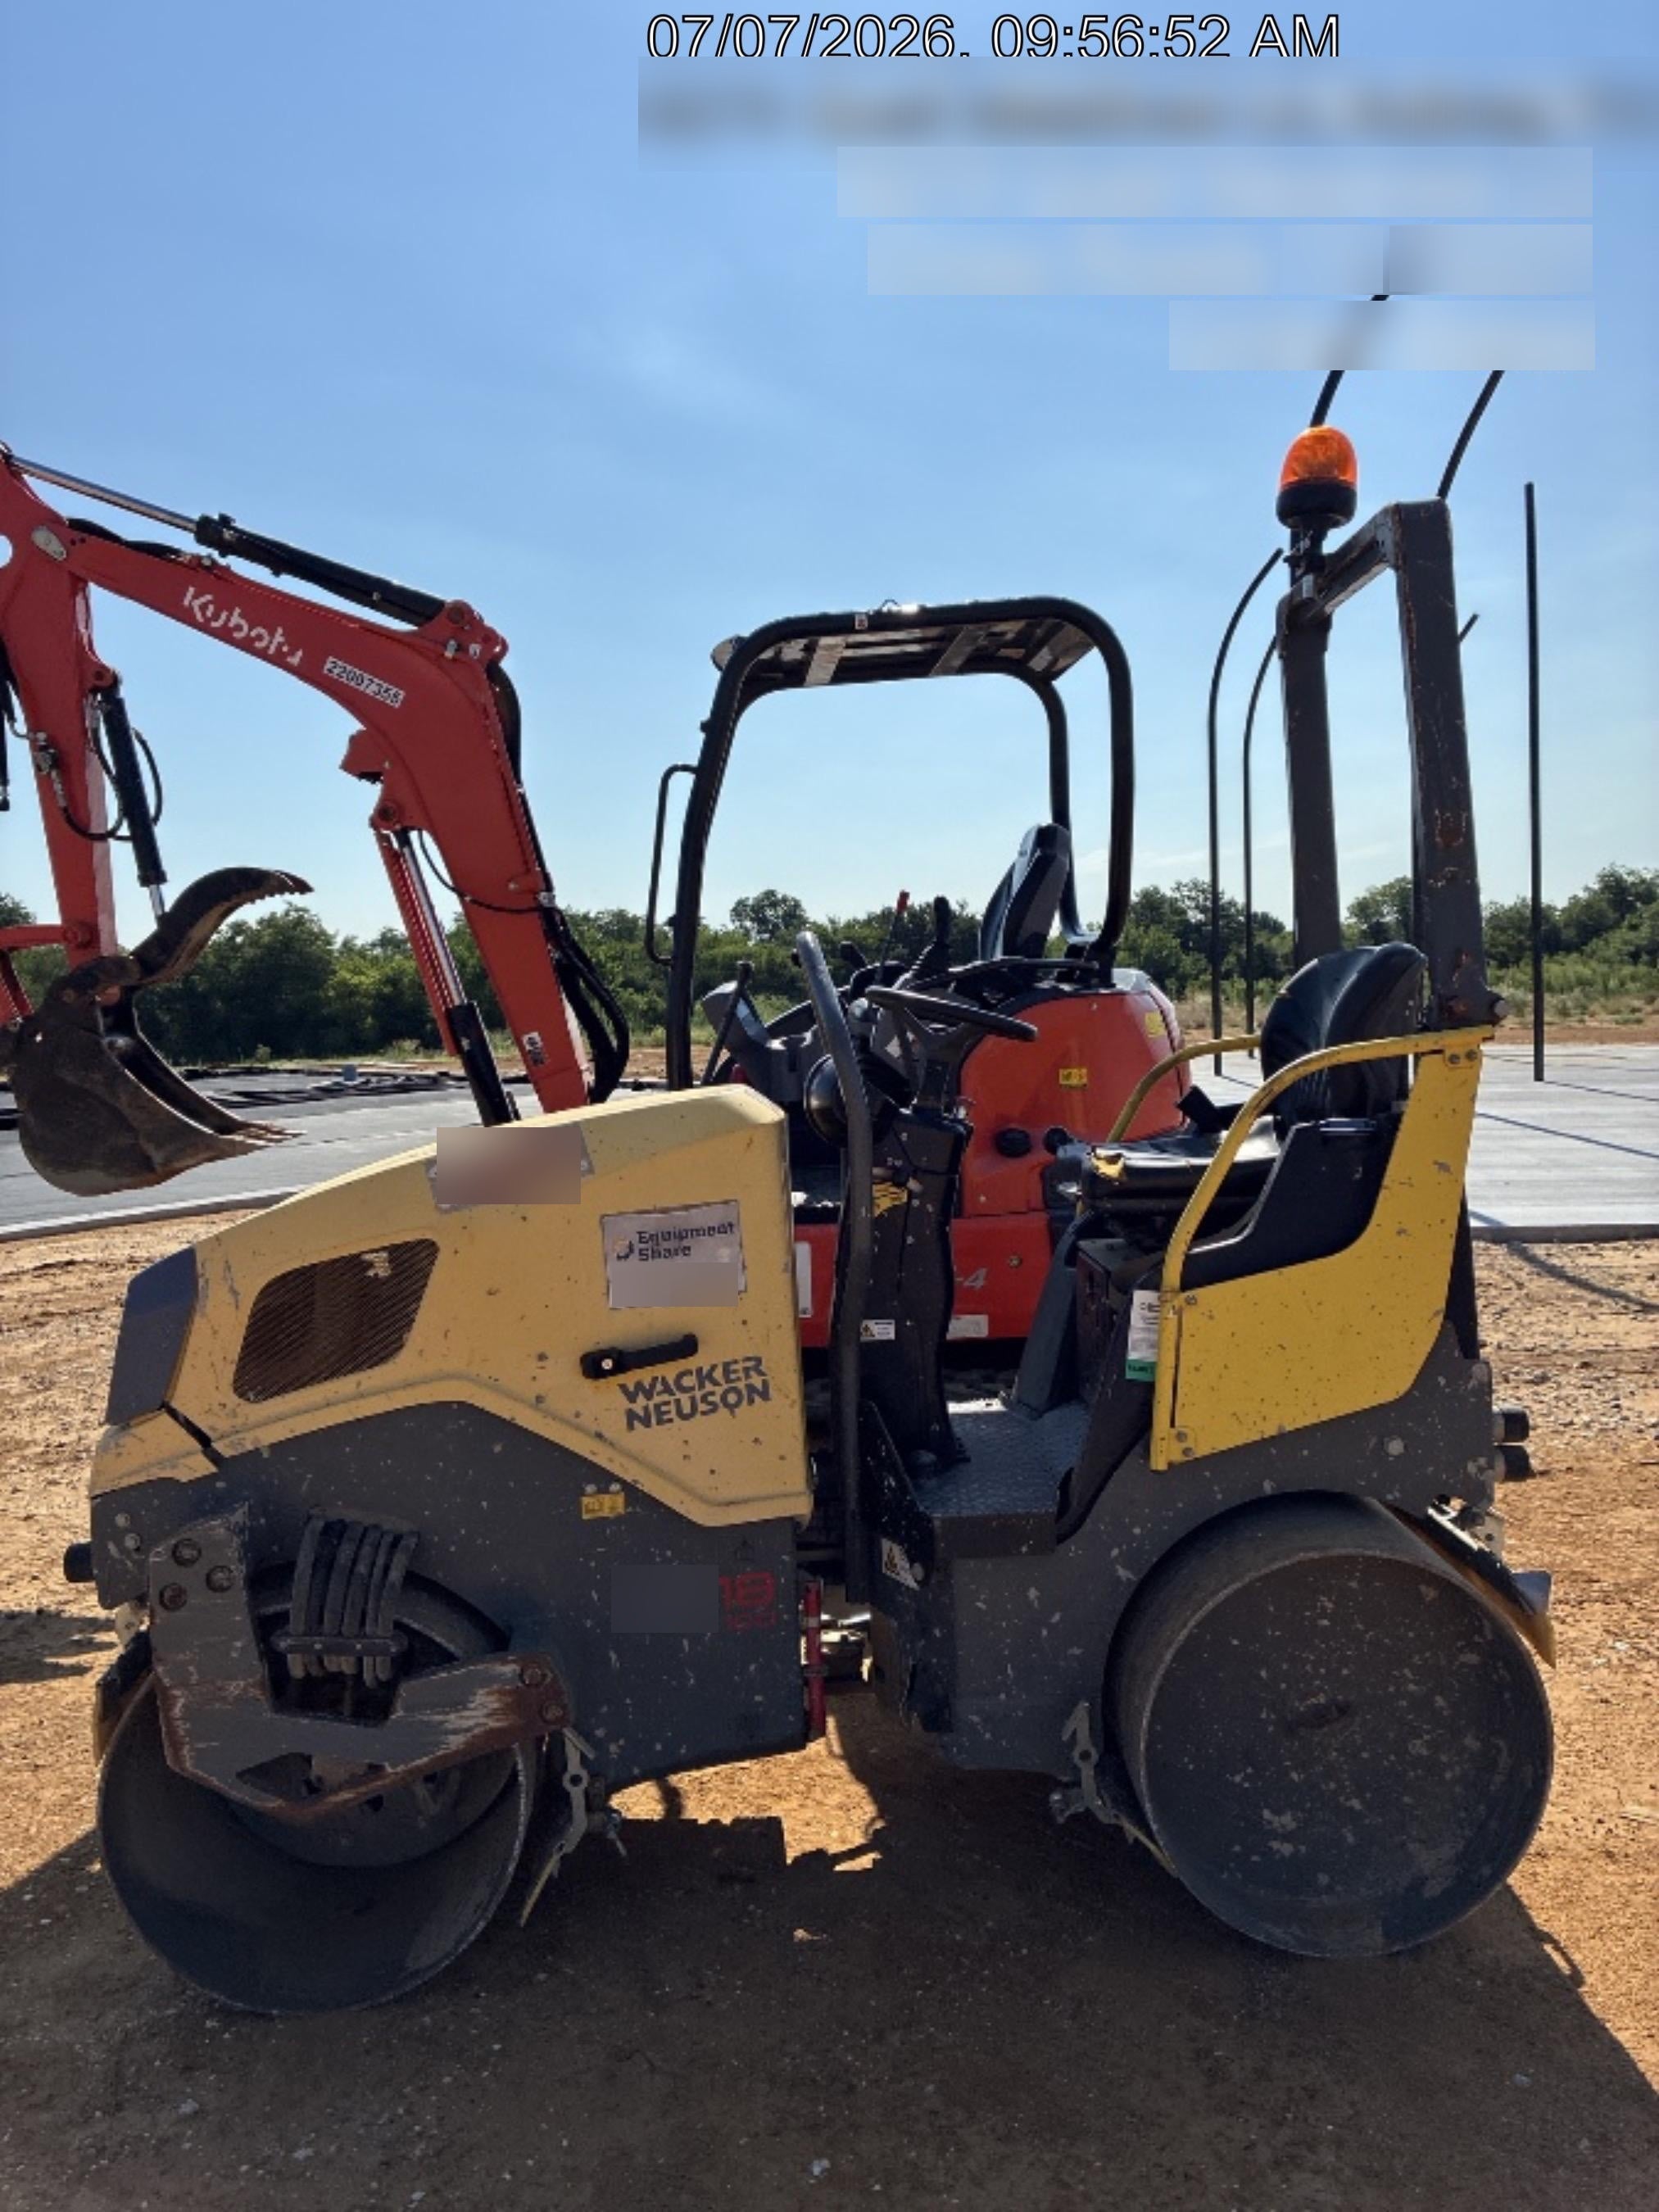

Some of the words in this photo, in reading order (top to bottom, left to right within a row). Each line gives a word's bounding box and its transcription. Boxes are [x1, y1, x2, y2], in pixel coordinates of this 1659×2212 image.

[637, 1221, 735, 1246] Equipment
[638, 1244, 691, 1262] Share
[617, 1356, 768, 1404] WACKER
[625, 1378, 772, 1433] NEUSON
